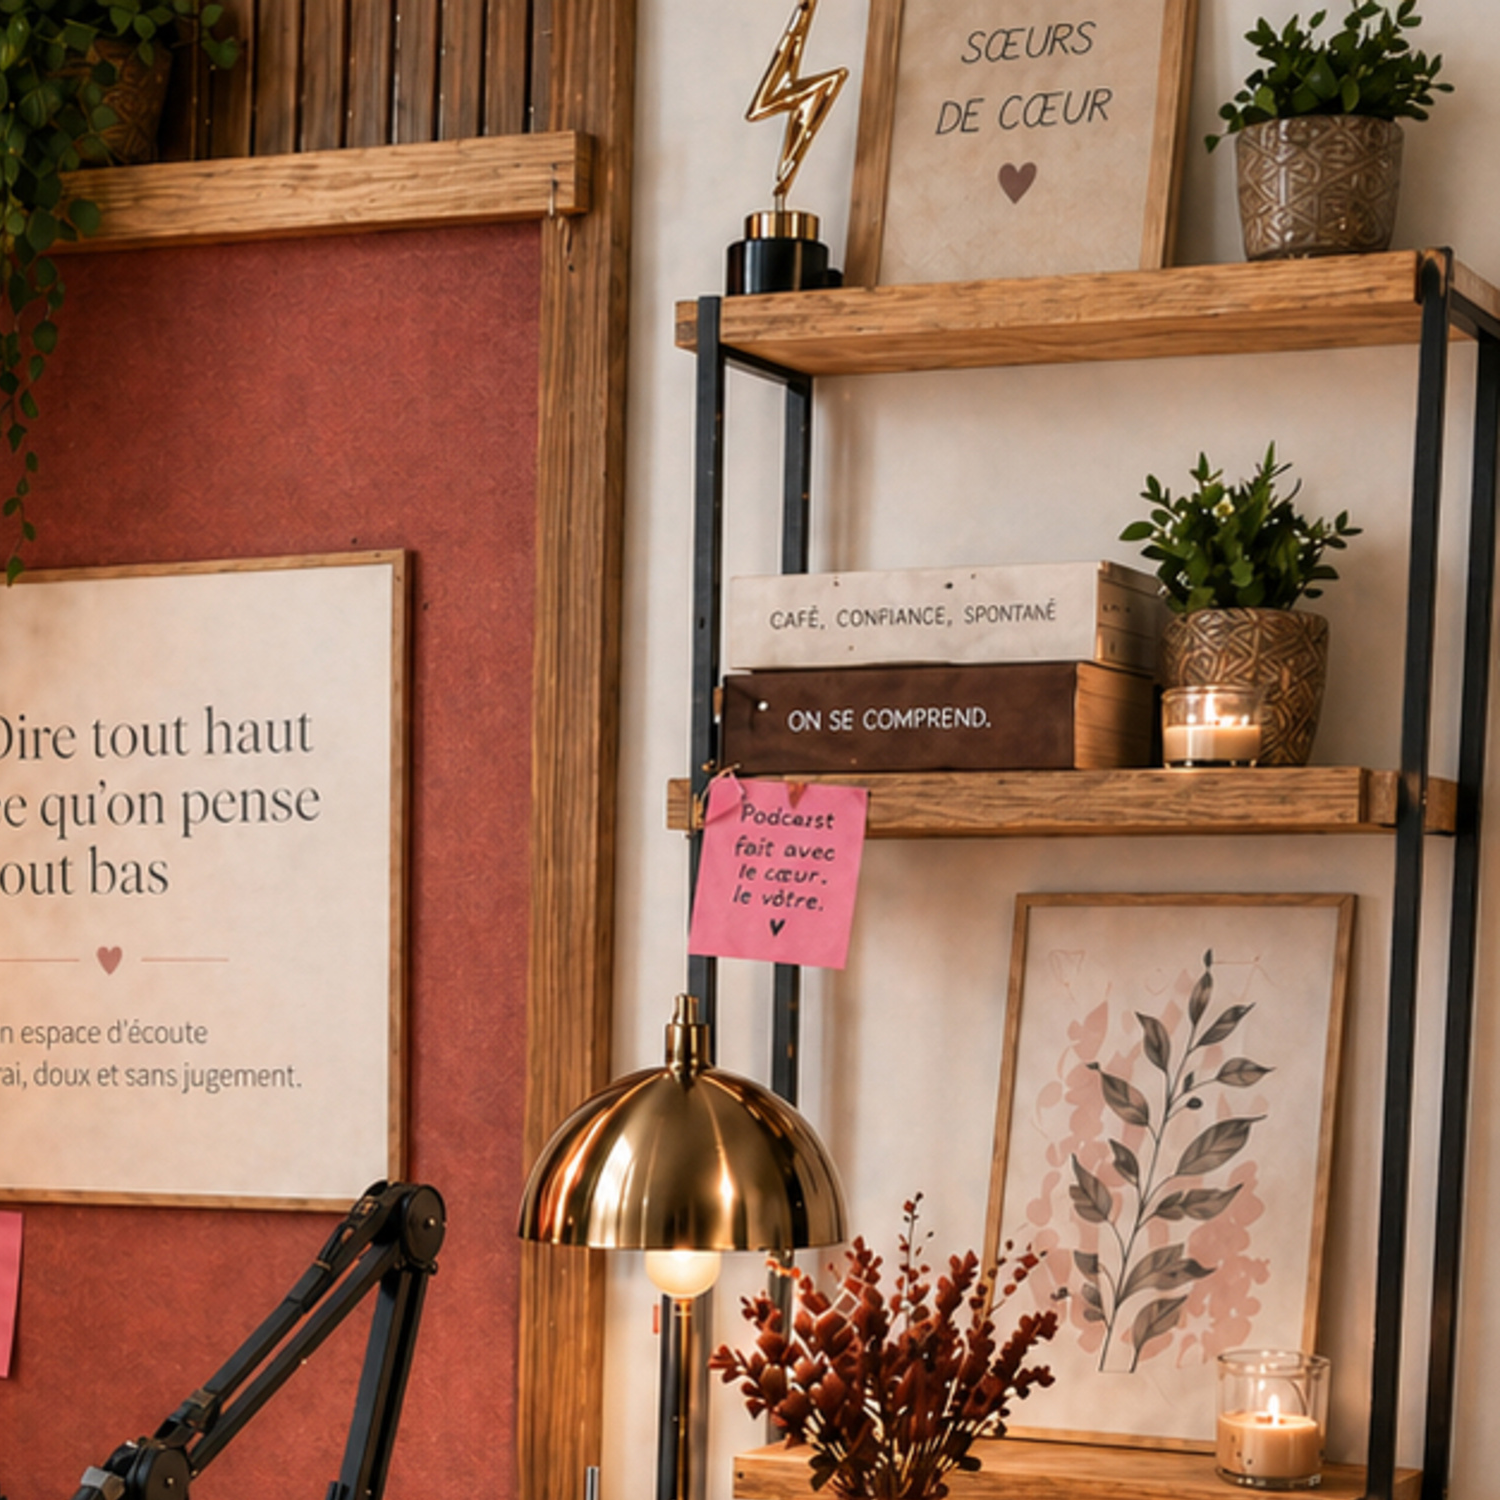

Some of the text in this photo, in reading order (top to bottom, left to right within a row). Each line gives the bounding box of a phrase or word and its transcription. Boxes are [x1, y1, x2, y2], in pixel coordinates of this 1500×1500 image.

[960, 21, 1097, 65] SŒURS
[935, 88, 1113, 135] DE CŒUR
[964, 599, 1056, 623] SPONTANÉ
[93, 714, 190, 759] tout
[204, 705, 313, 756] haut
[788, 707, 992, 732] ON SE COMPREND.
[182, 785, 321, 838] pense
[734, 835, 835, 861] fait avec
[89, 845, 170, 895] bas
[738, 863, 757, 881] le
[732, 885, 751, 904] le
[20, 1023, 101, 1050] espace
[33, 1061, 90, 1088] doux
[97, 1063, 119, 1087] et
[124, 1068, 178, 1088] sans
[181, 1062, 302, 1094] jugement.
